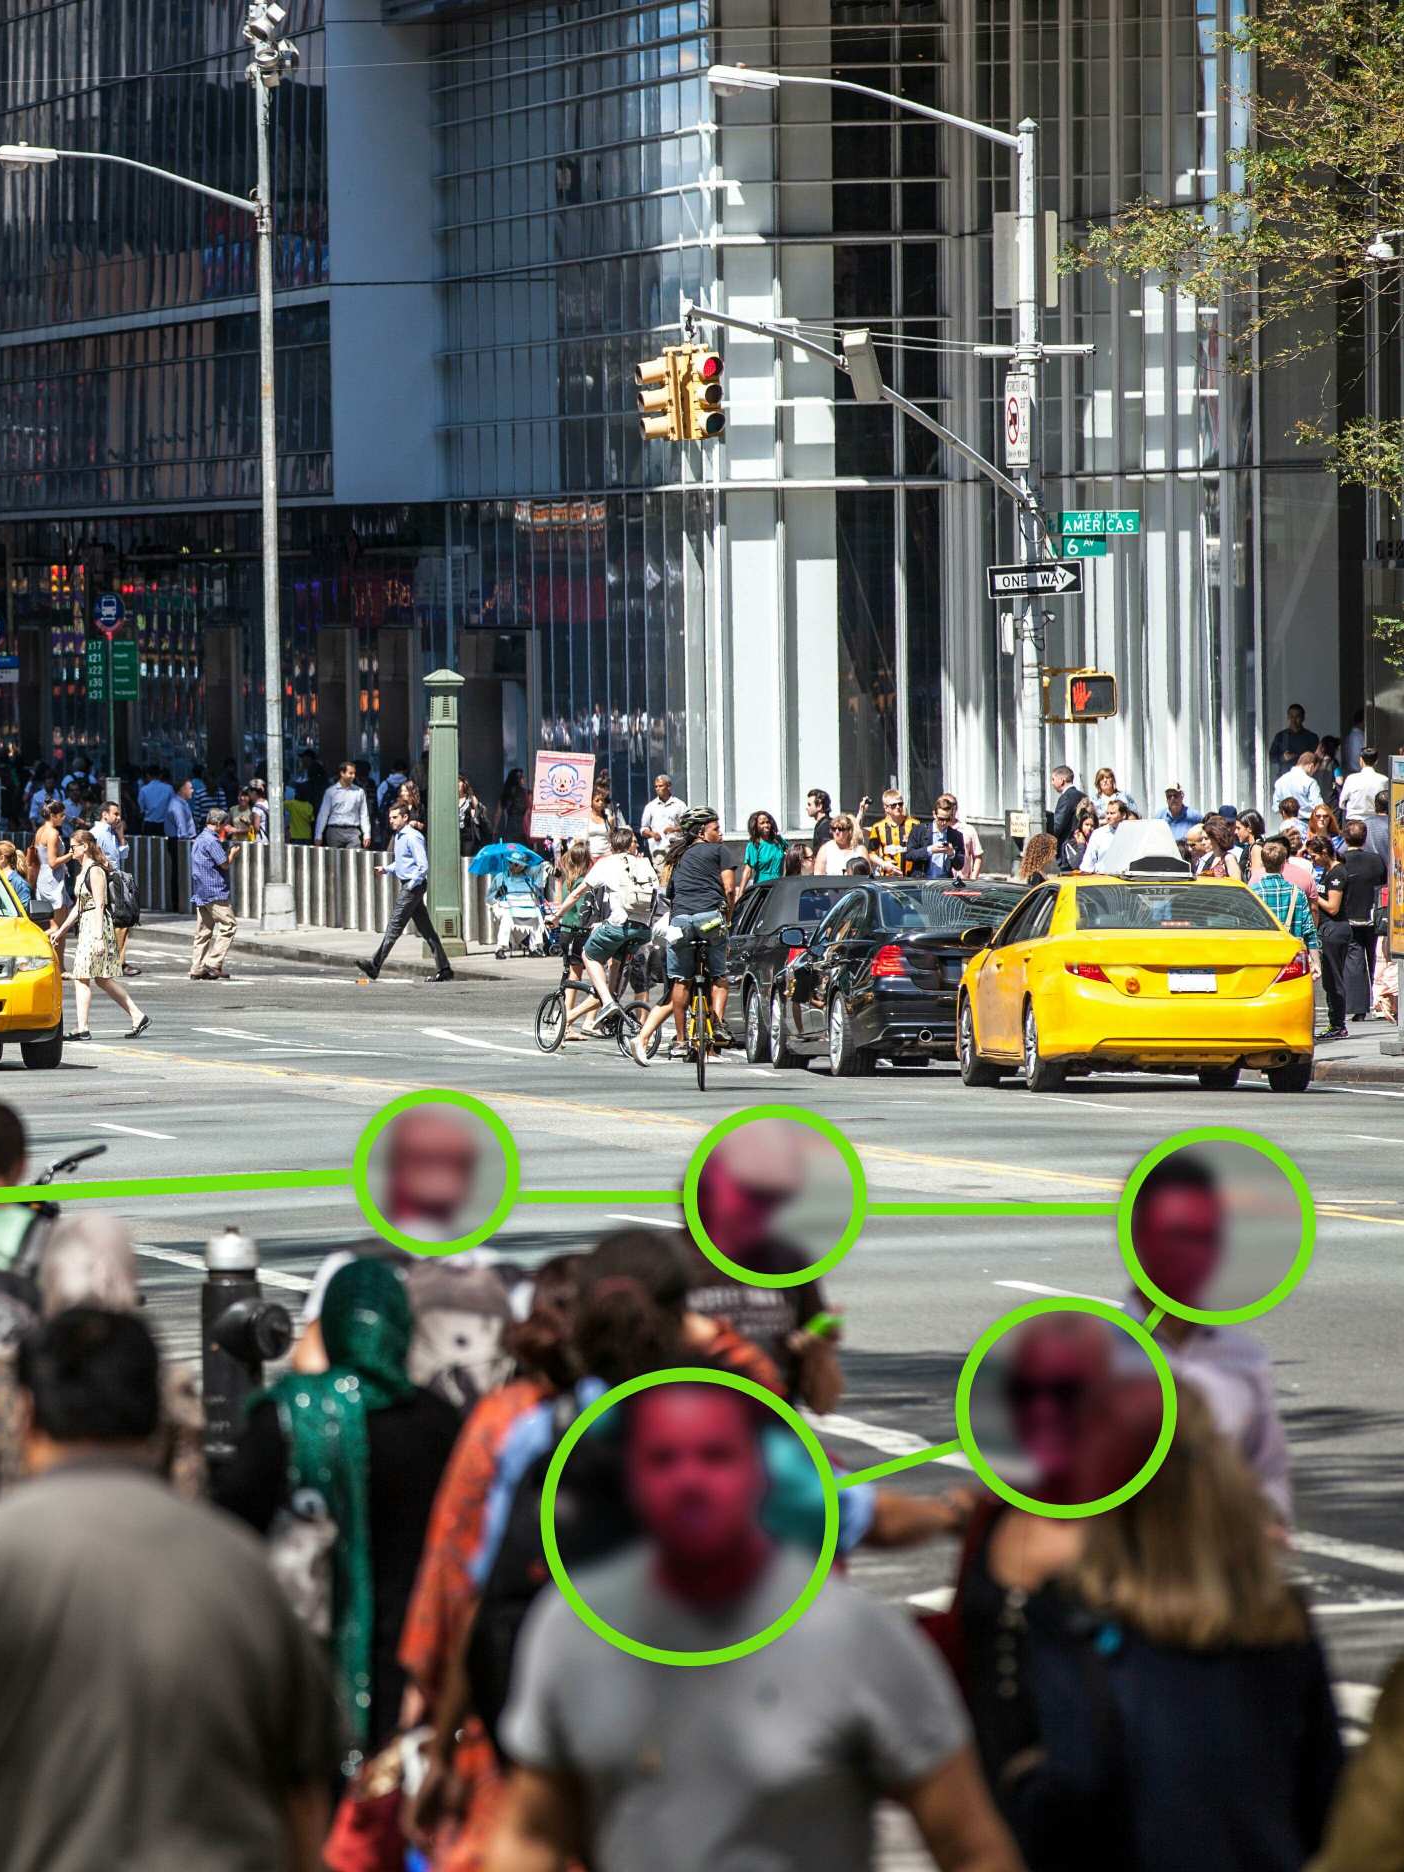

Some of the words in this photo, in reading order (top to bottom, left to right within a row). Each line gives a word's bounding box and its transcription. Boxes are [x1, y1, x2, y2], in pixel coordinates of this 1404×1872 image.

[1063, 519, 1134, 532] AMERICAS
[1067, 538, 1079, 555] 6
[1083, 539, 1095, 547] AV
[1002, 575, 1027, 588] ONE
[1040, 572, 1067, 586] WAY
